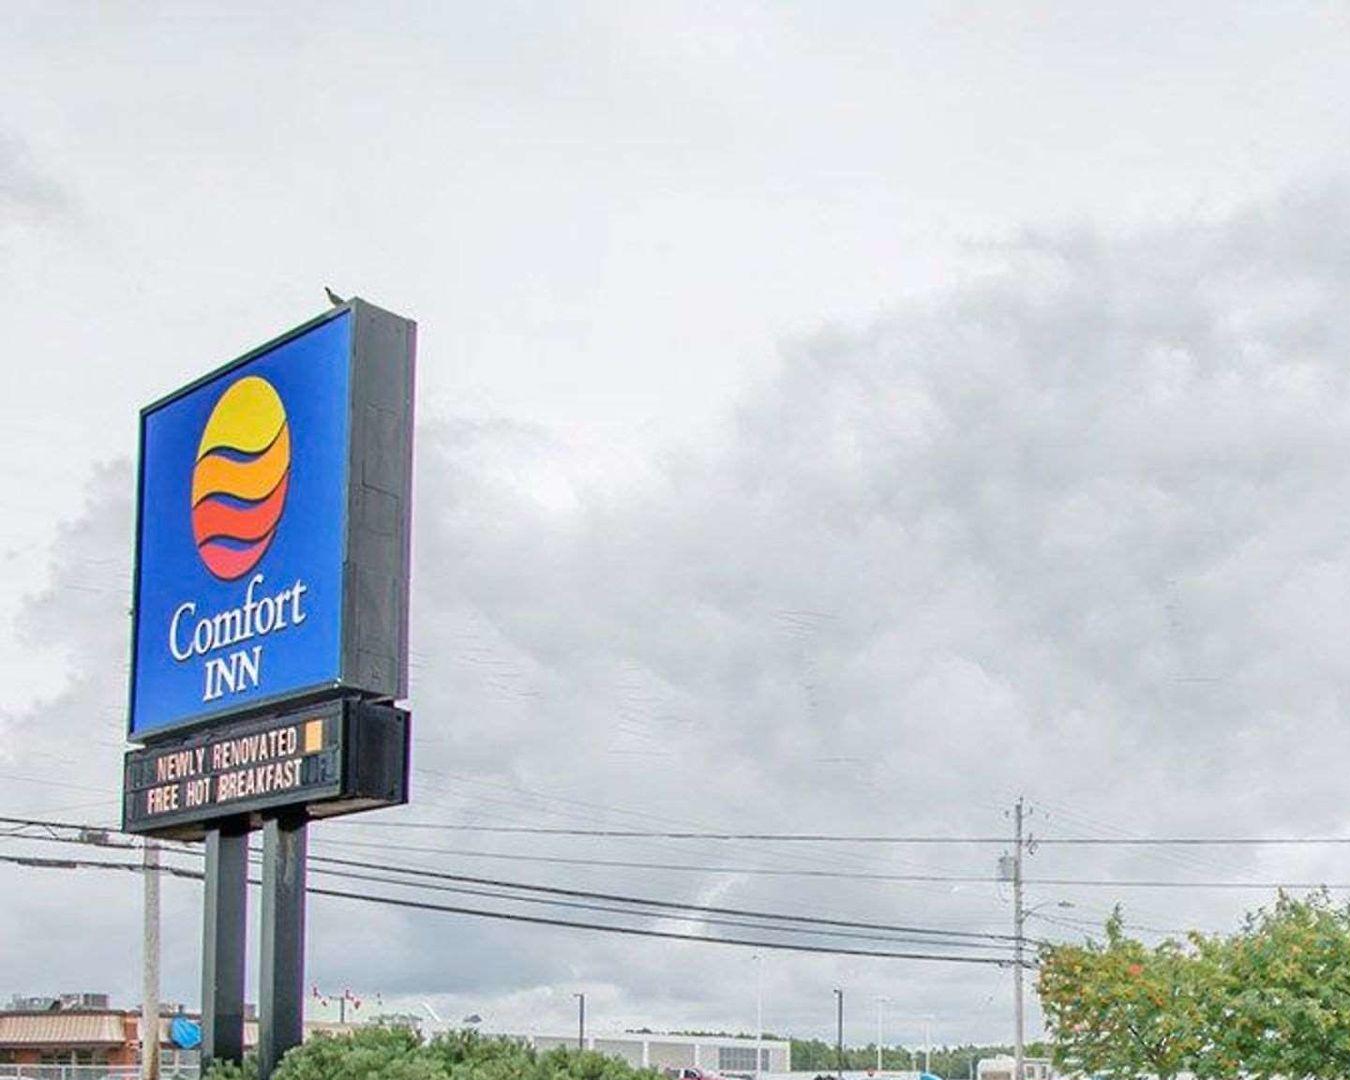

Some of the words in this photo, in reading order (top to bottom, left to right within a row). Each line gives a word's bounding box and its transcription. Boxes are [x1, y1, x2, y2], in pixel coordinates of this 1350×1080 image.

[169, 573, 307, 662] Comfort
[202, 645, 263, 702] INN
[157, 747, 205, 782] NEWLY
[213, 726, 298, 769] RENOVATED
[147, 784, 179, 814] FREE
[186, 777, 211, 807] HOT
[216, 758, 303, 803] BREAKFAST
